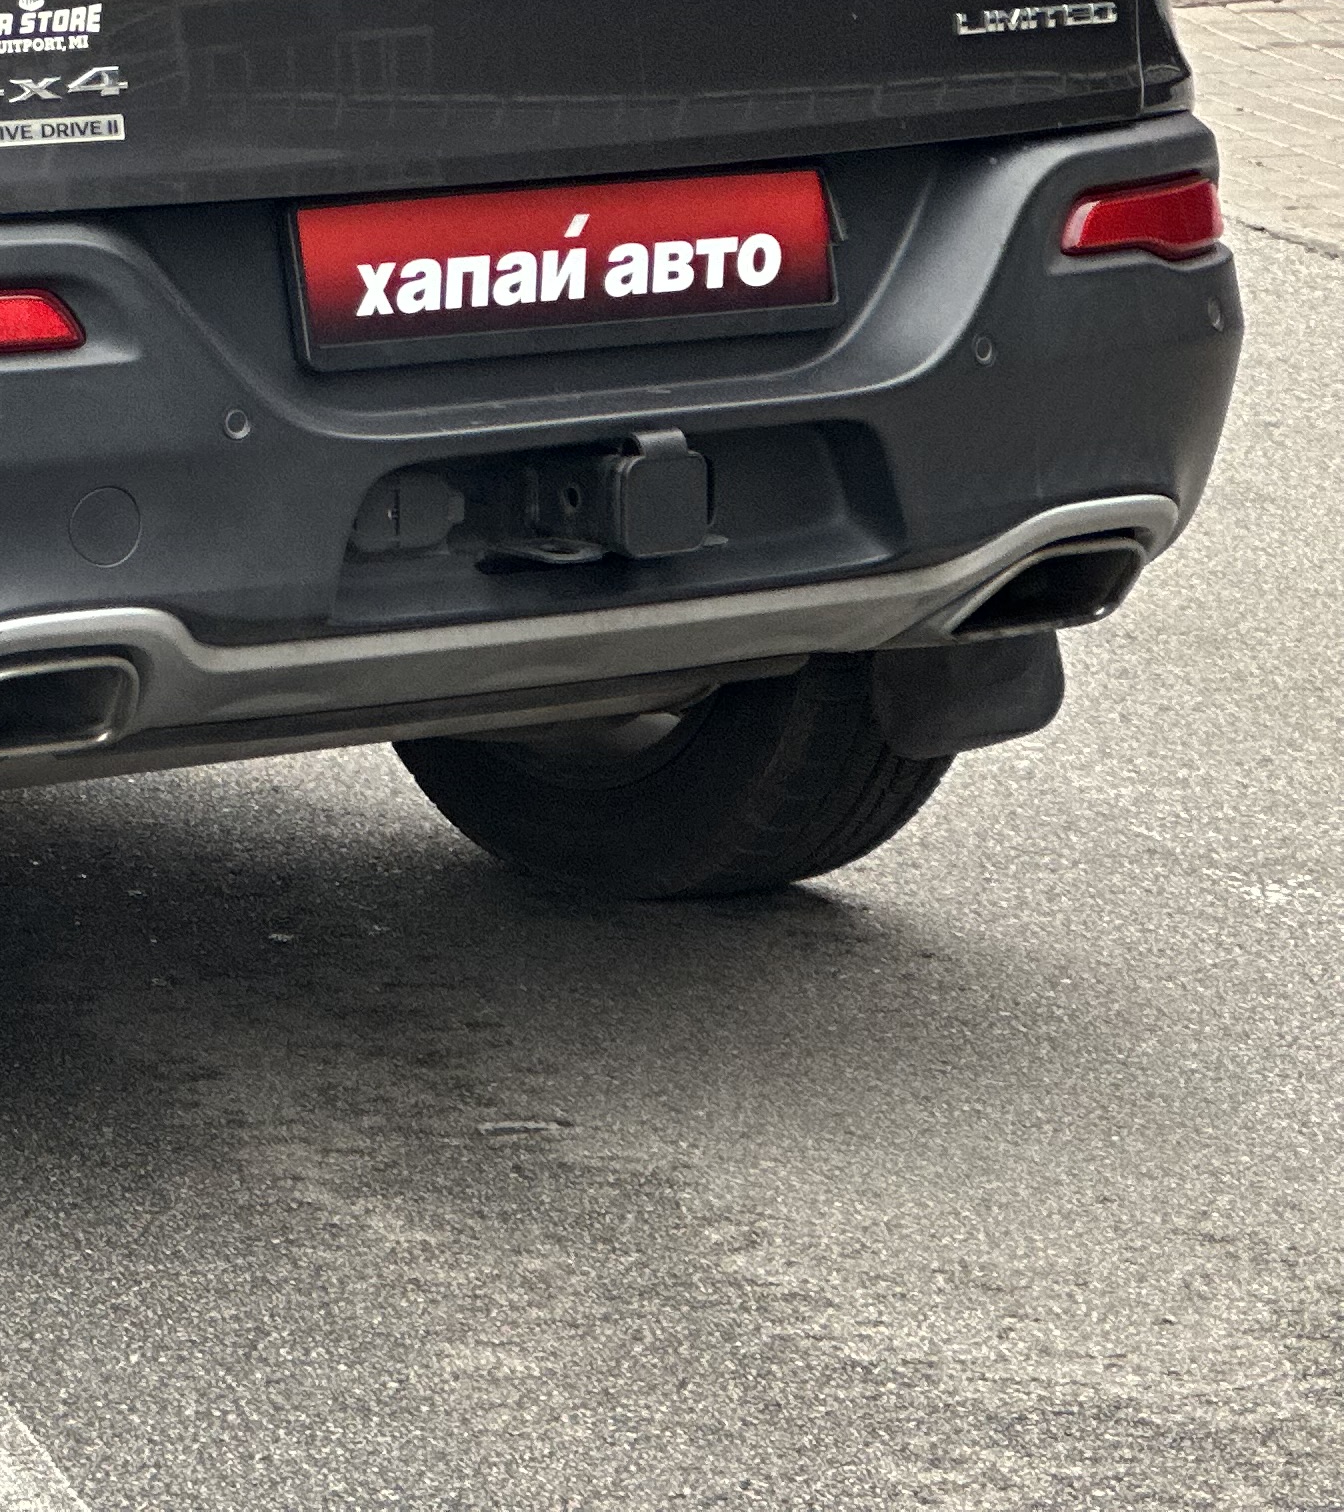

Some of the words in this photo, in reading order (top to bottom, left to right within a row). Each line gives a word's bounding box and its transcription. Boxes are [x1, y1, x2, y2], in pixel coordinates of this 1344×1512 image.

[19, 3, 103, 34] STORE
[955, 1, 1118, 36] LIMITED
[68, 35, 89, 50] MI
[41, 120, 103, 139] DRIVE
[107, 119, 119, 136] II
[604, 233, 783, 299] авто
